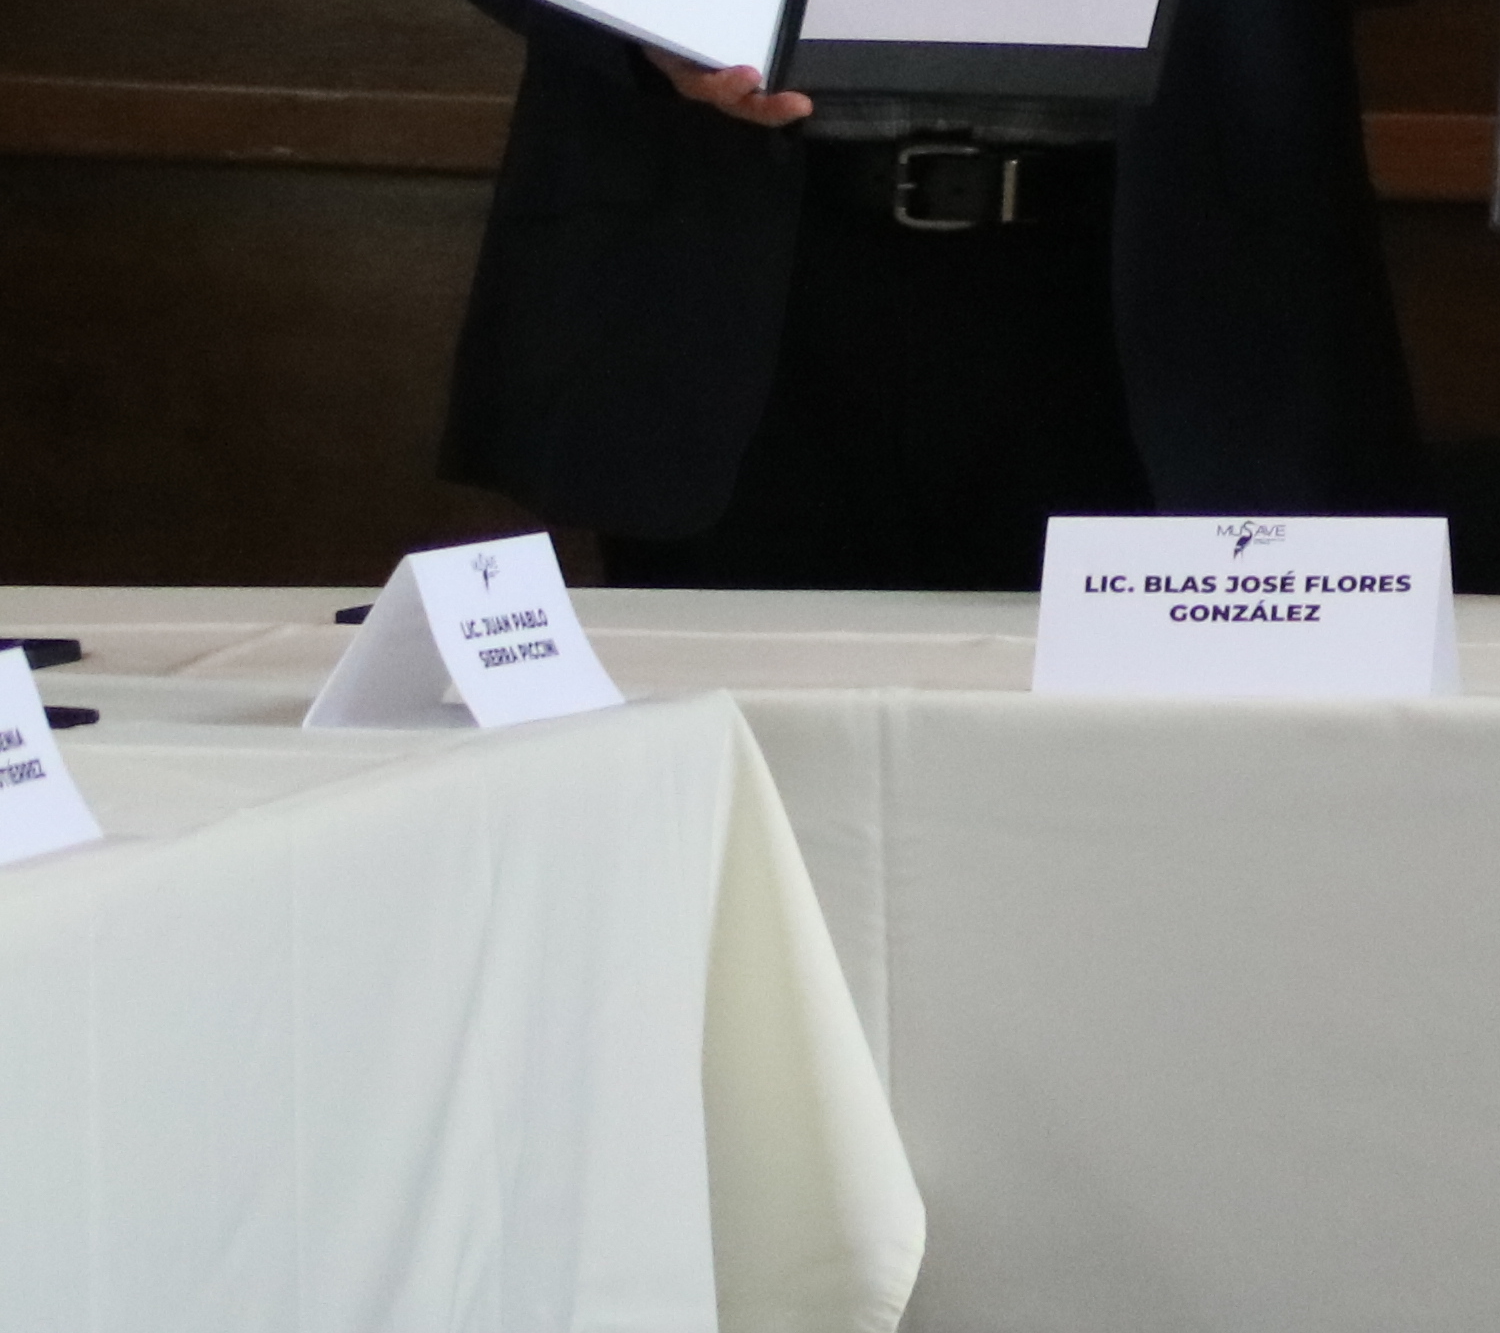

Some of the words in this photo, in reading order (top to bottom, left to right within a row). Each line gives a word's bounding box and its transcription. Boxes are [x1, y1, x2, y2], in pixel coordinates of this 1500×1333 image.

[1217, 520, 1286, 538] MUSAVE
[1084, 575, 1135, 594] LIC.
[1144, 575, 1217, 593] BLAS
[1225, 570, 1296, 594] JOSÉ
[1305, 574, 1412, 593] FLORES
[1169, 600, 1321, 623] GONZÁLEZ
[460, 618, 483, 640] LIC.
[481, 614, 513, 636] JUAN
[511, 608, 549, 631] PABLO
[478, 646, 519, 669] SIERRA
